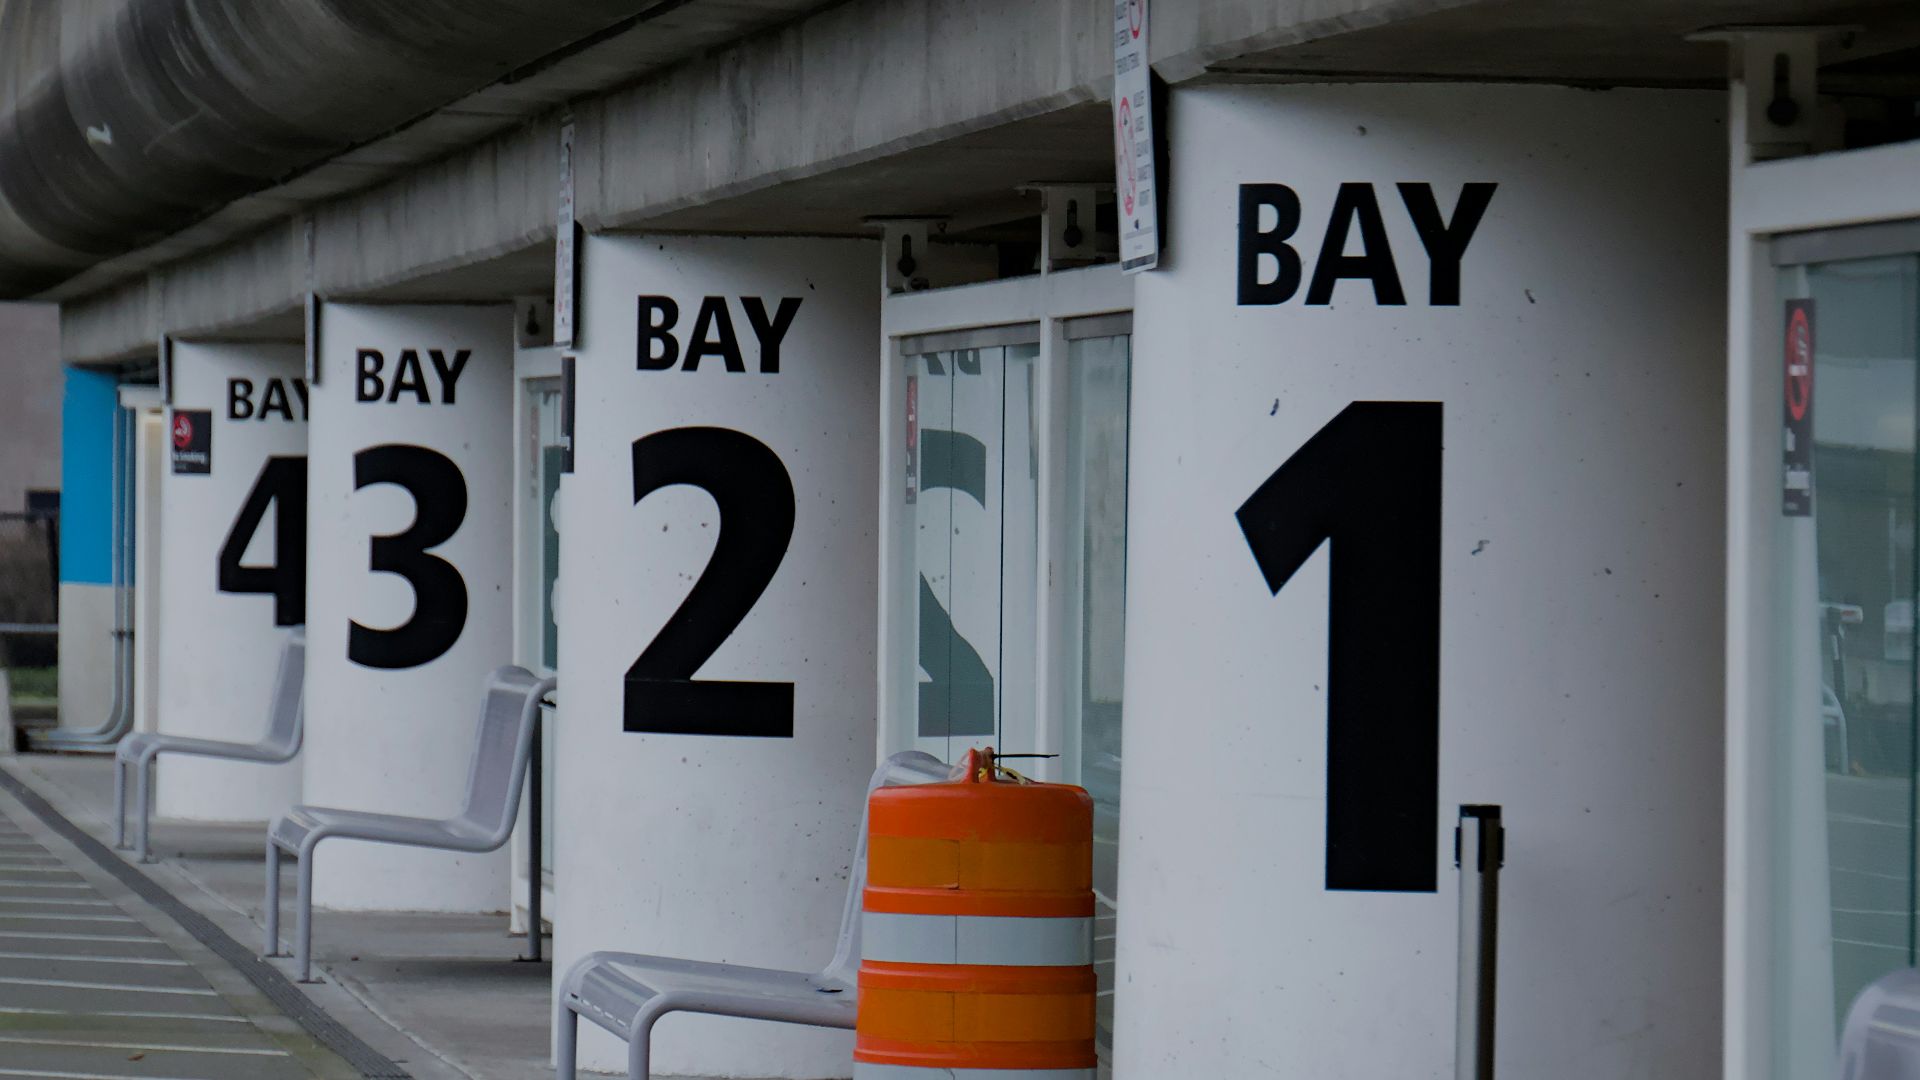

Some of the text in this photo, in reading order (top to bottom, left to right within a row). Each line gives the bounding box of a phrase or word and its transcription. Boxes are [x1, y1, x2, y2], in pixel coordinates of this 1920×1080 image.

[1237, 182, 1498, 306] BAY
[357, 349, 472, 405] BAY
[637, 295, 803, 373] BAY
[218, 455, 308, 628] 4
[348, 444, 468, 669] 3
[624, 426, 796, 738] 2
[1235, 400, 1444, 892] 1
